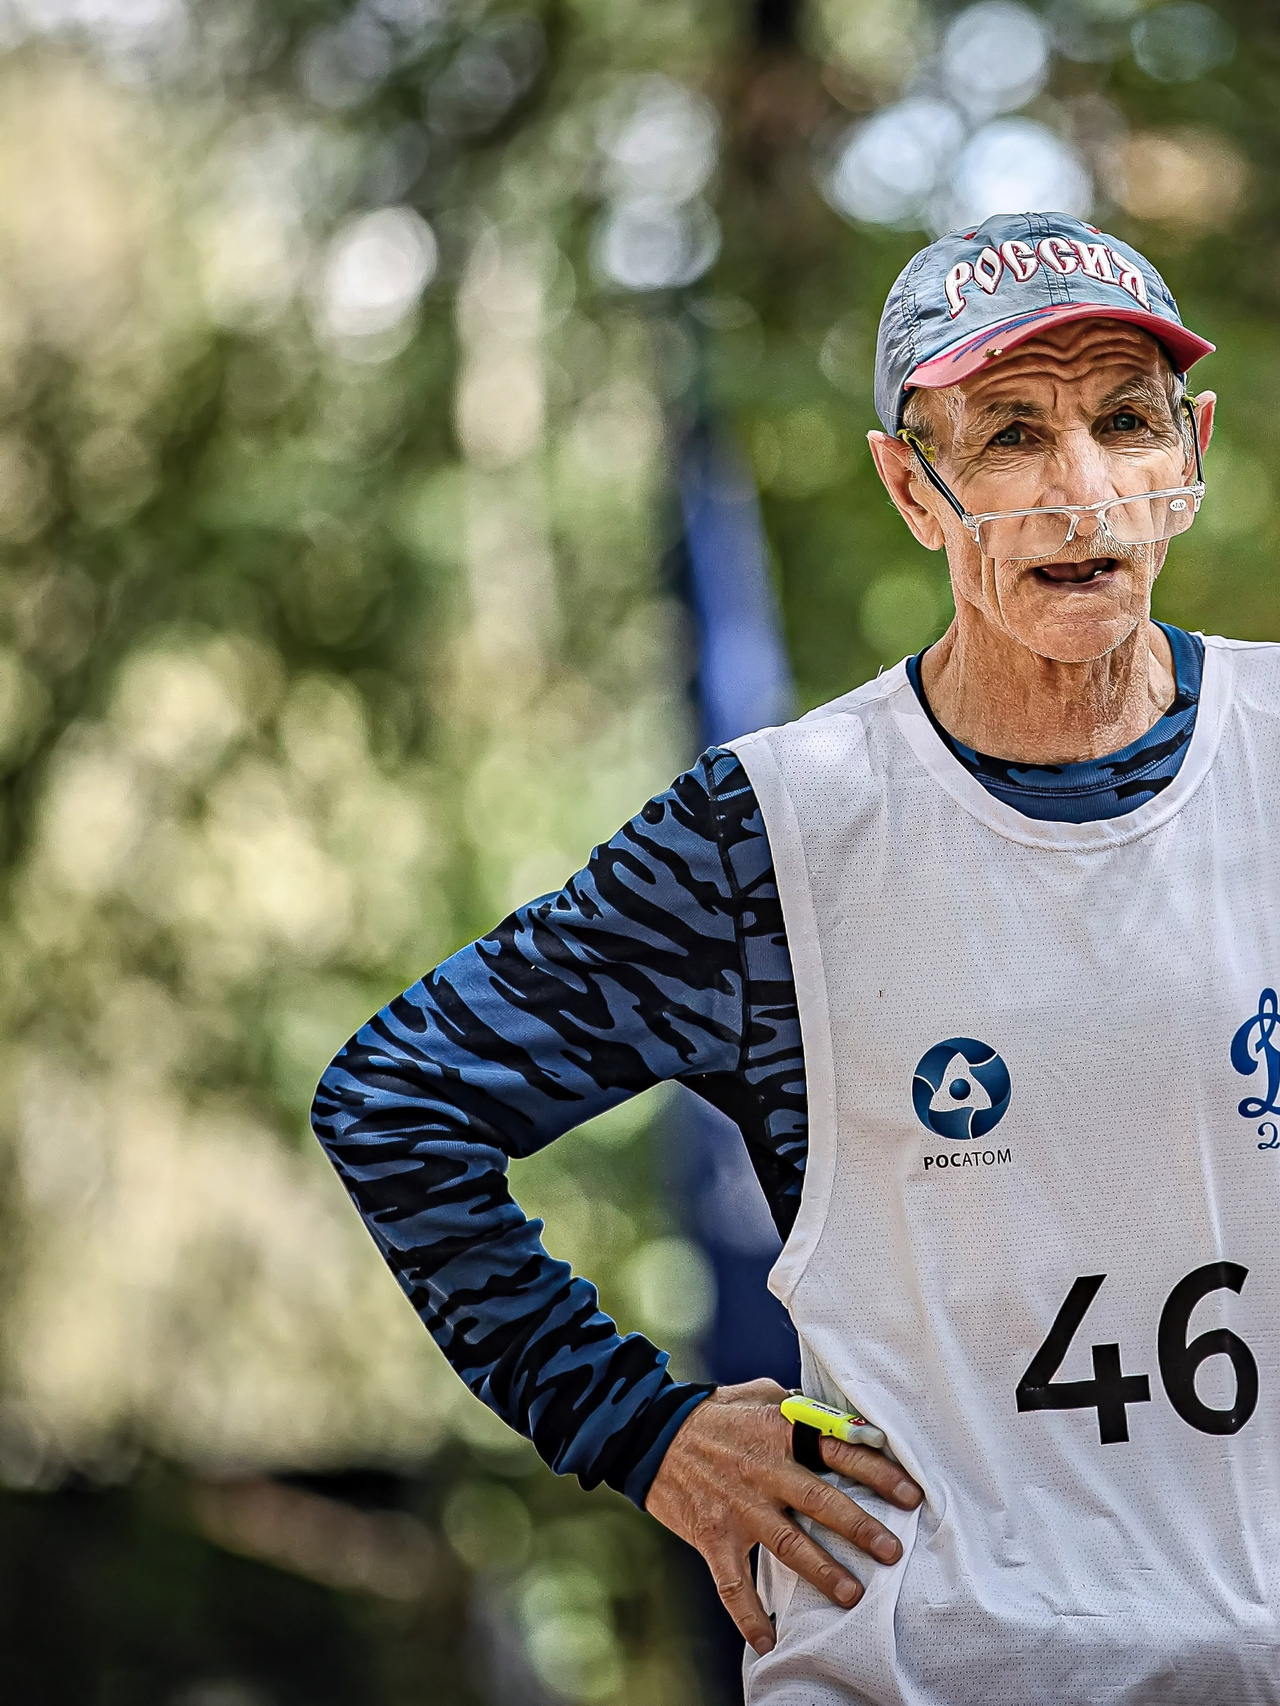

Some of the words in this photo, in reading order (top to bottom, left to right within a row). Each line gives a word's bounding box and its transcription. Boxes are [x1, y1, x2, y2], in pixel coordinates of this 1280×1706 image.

[943, 236, 1153, 320] РОССИЯ
[923, 1148, 1012, 1171] РОСАТОМ
[1015, 1260, 1259, 1446] 46
